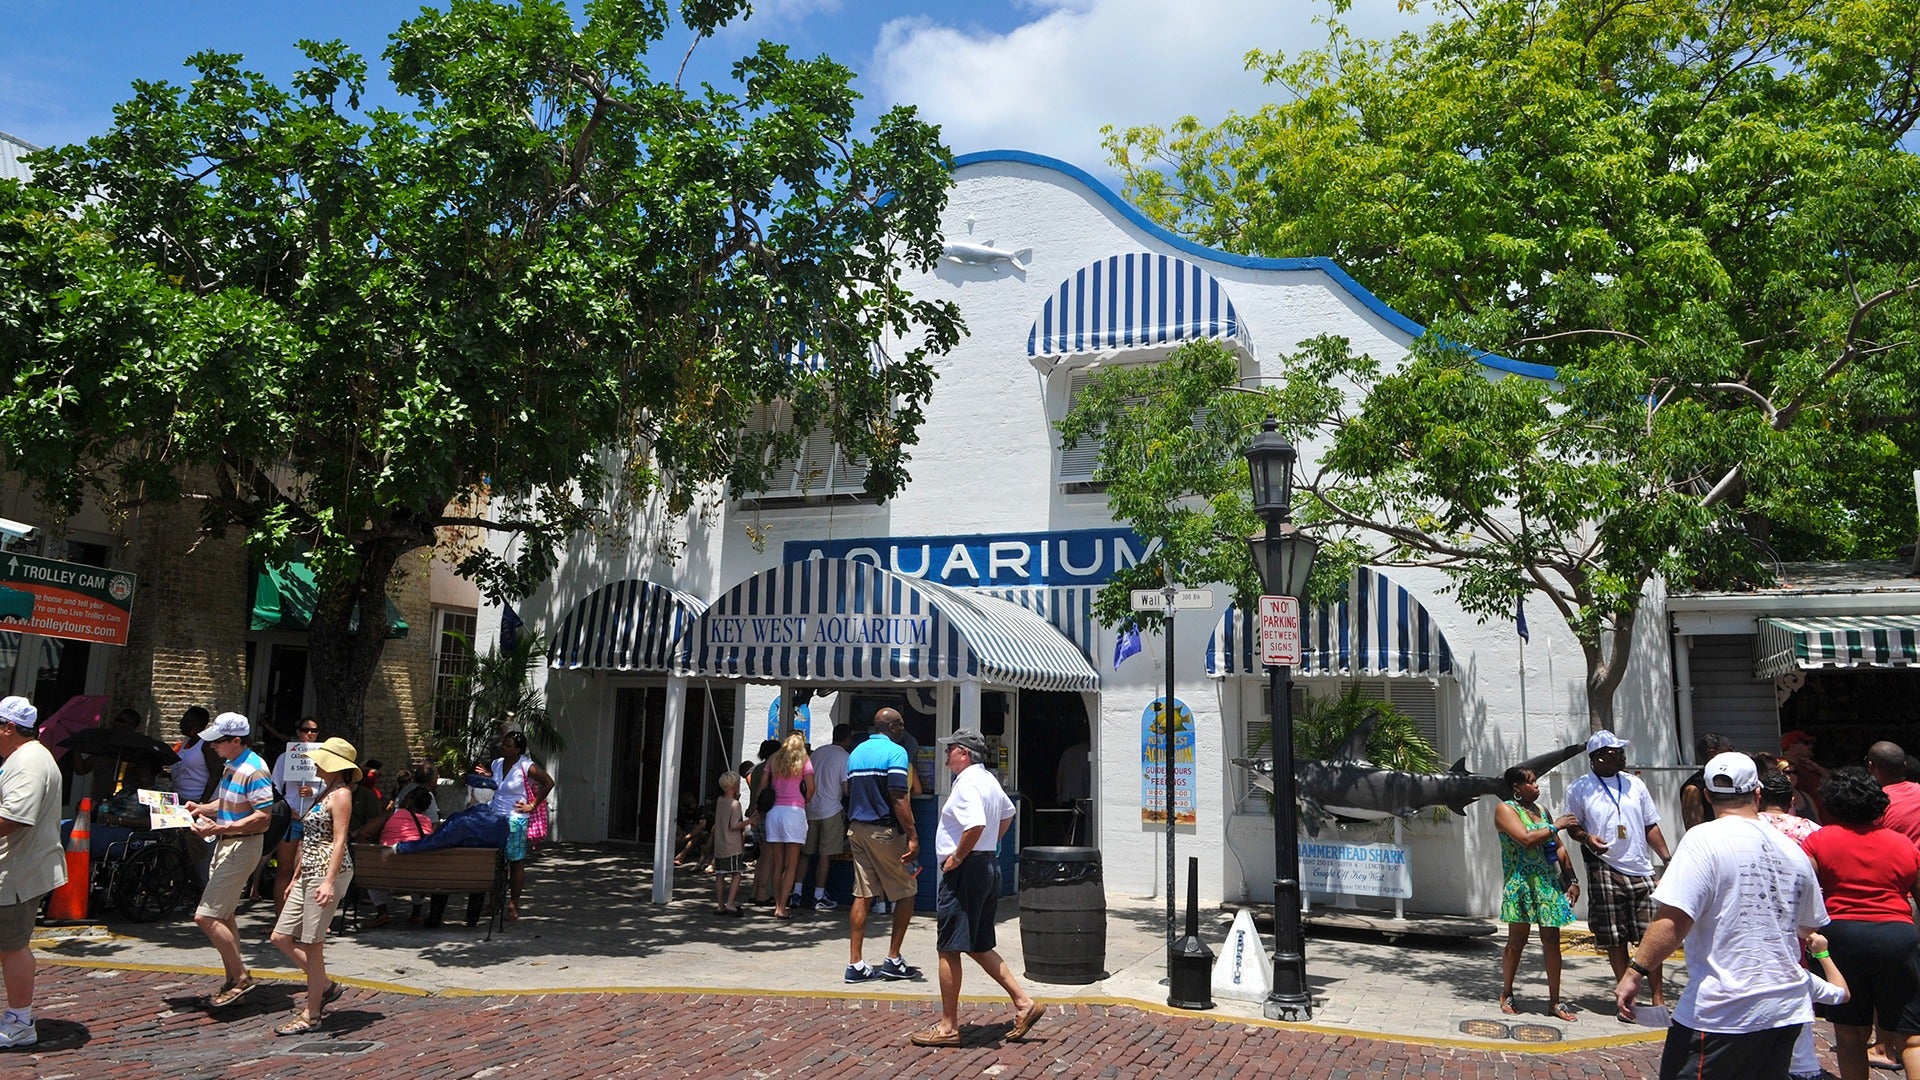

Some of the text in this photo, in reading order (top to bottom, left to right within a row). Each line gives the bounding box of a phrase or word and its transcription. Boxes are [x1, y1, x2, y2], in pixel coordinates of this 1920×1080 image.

[23, 564, 76, 585] TROLLEY
[78, 574, 105, 590] CAM
[43, 594, 63, 604] home
[64, 597, 76, 606] and
[78, 598, 88, 607] tell
[89, 602, 104, 610] your
[1141, 594, 1175, 606] Wall St
[1272, 601, 1287, 613] NO
[47, 606, 56, 614] on
[57, 606, 69, 615] the
[69, 608, 84, 618] Live
[84, 610, 105, 621] Trolley
[106, 613, 121, 623] Cam
[0, 615, 116, 637] ww.trolleytours.com
[1263, 615, 1297, 629] PARKING
[710, 616, 928, 645] KEY WEST AQUARIUM
[1264, 630, 1297, 640] BETWEEN
[1270, 642, 1293, 651] SIGNS
[1144, 745, 1194, 762] AQUIUM
[1174, 767, 1192, 776] OURS
[1151, 777, 1187, 786] FEEGS
[1369, 848, 1406, 864] SHARK
[1351, 869, 1367, 881] Key
